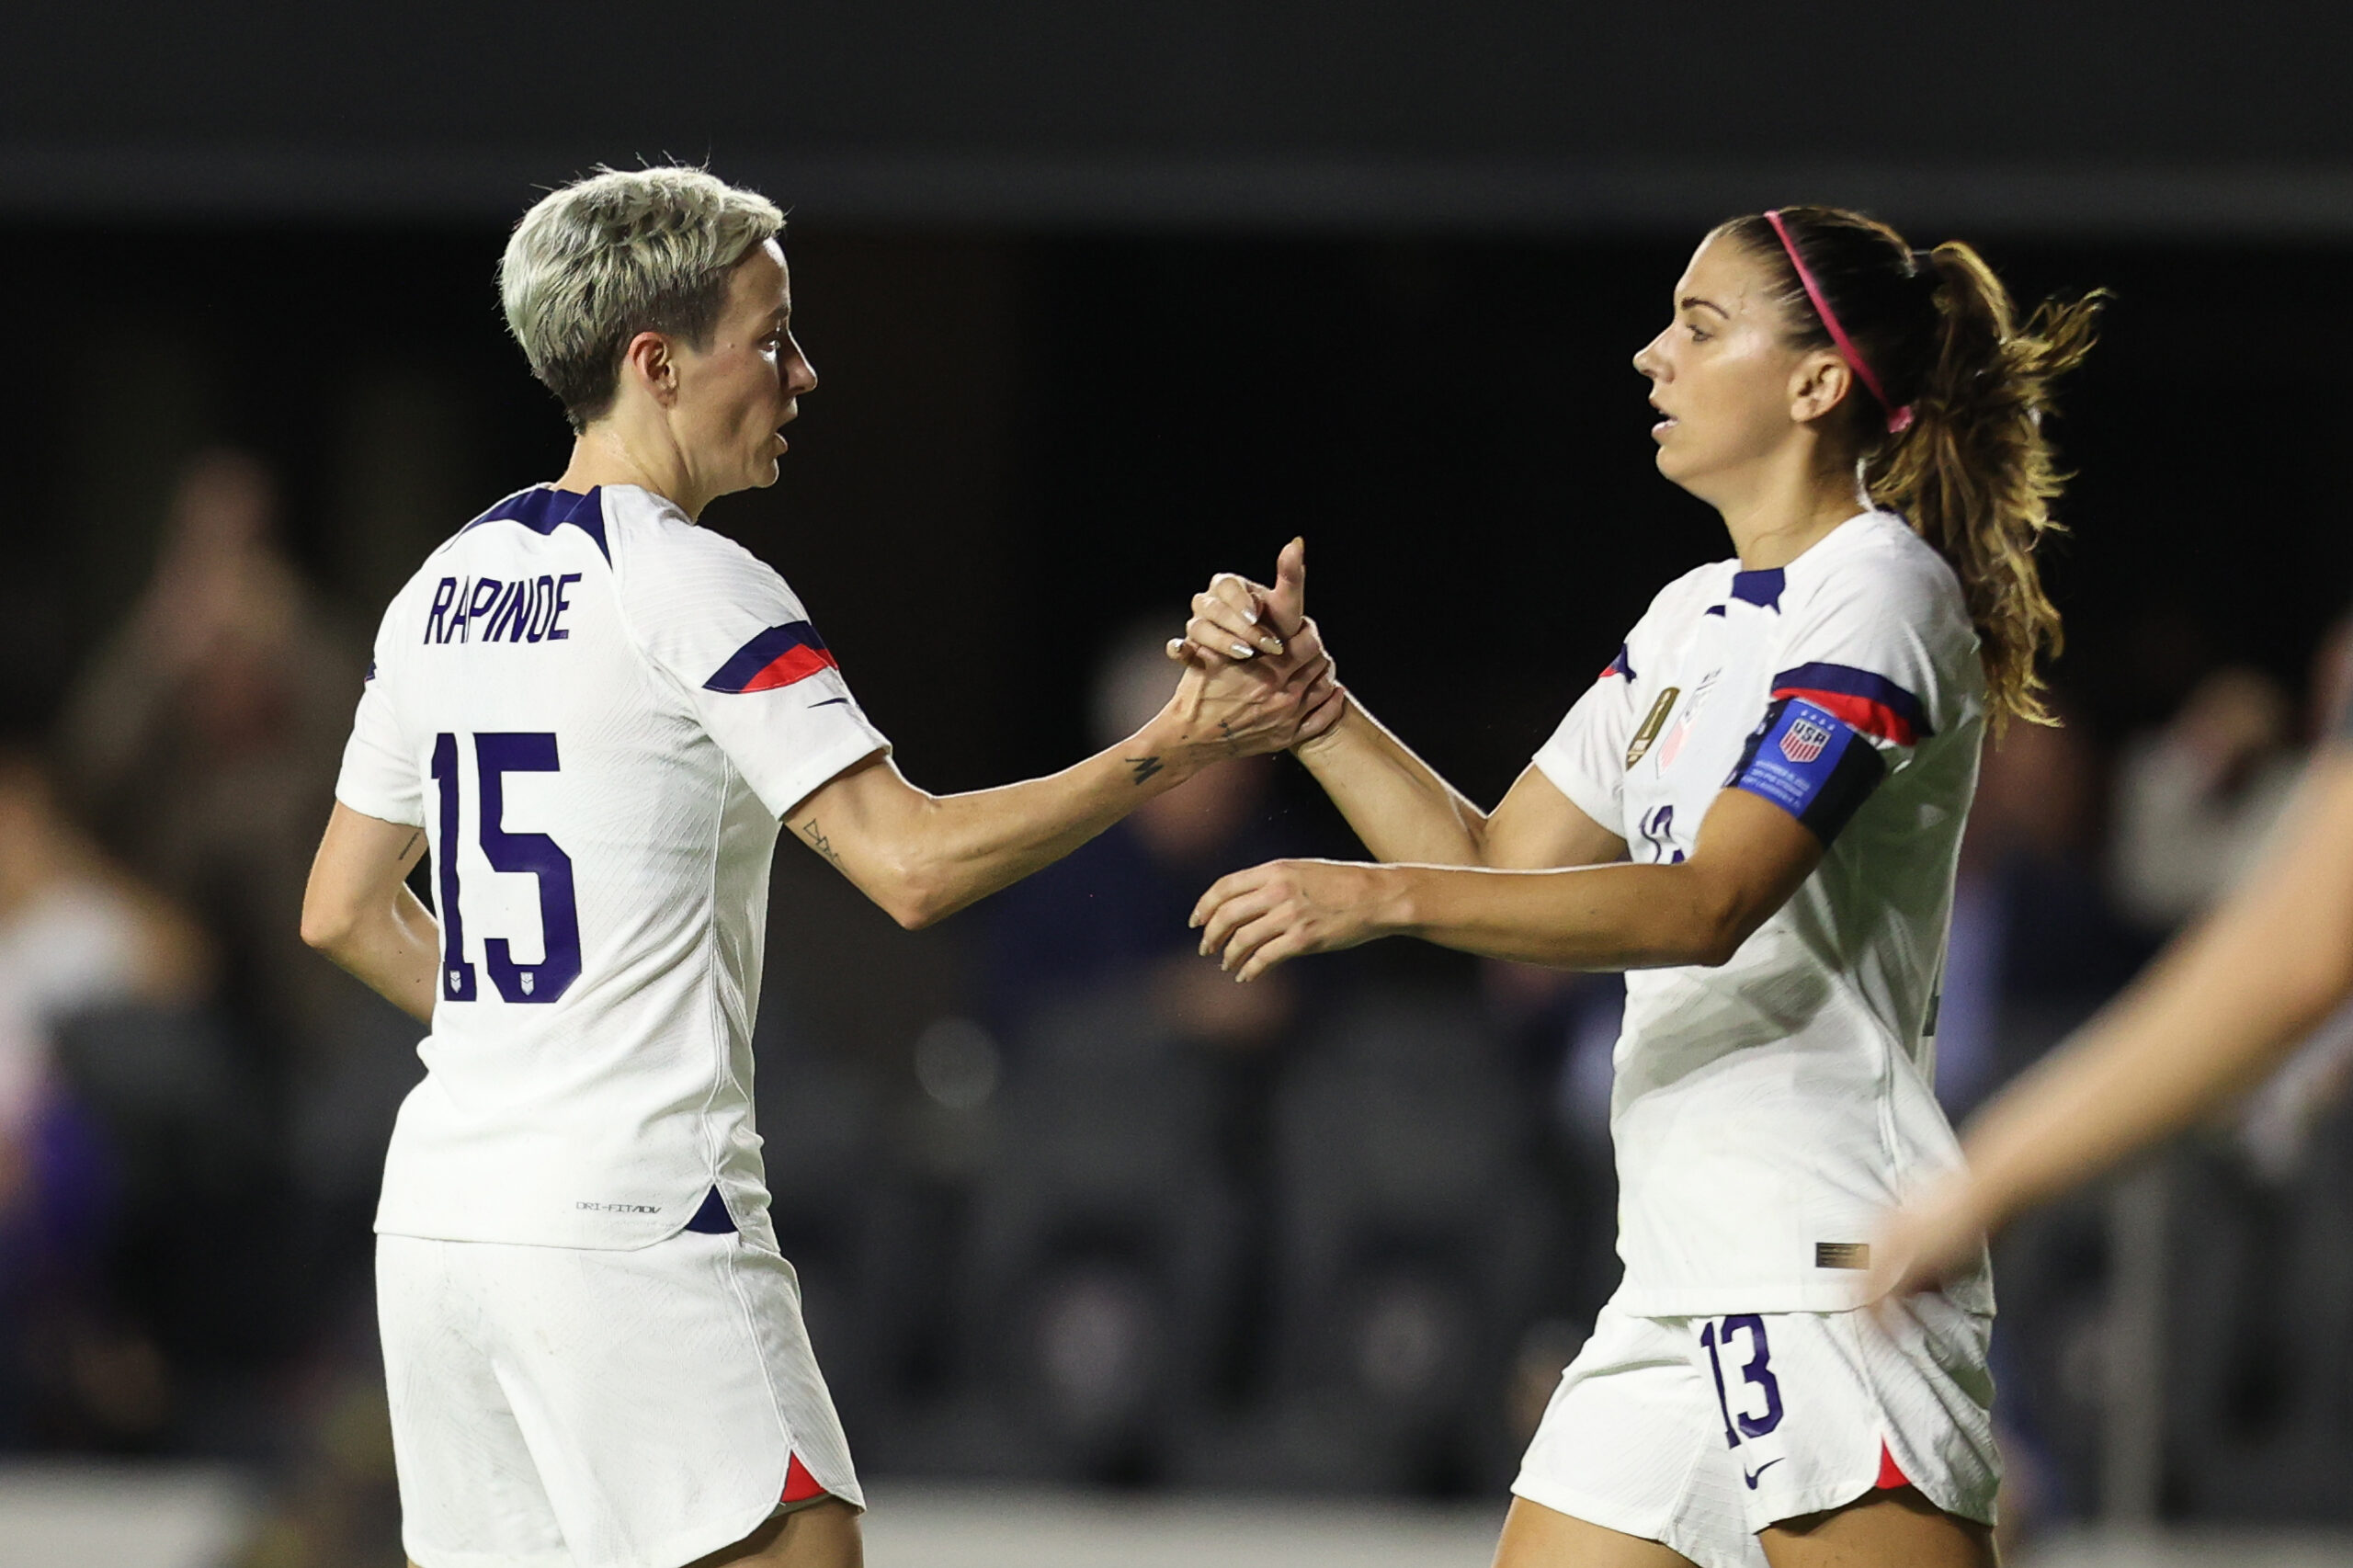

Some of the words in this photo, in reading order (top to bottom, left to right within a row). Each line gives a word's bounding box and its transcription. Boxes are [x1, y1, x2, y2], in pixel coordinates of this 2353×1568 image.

[424, 573, 582, 645] RAPINOE
[1793, 722, 1827, 745] USA
[431, 732, 583, 1004] 15
[1699, 1312, 1784, 1449] 13
